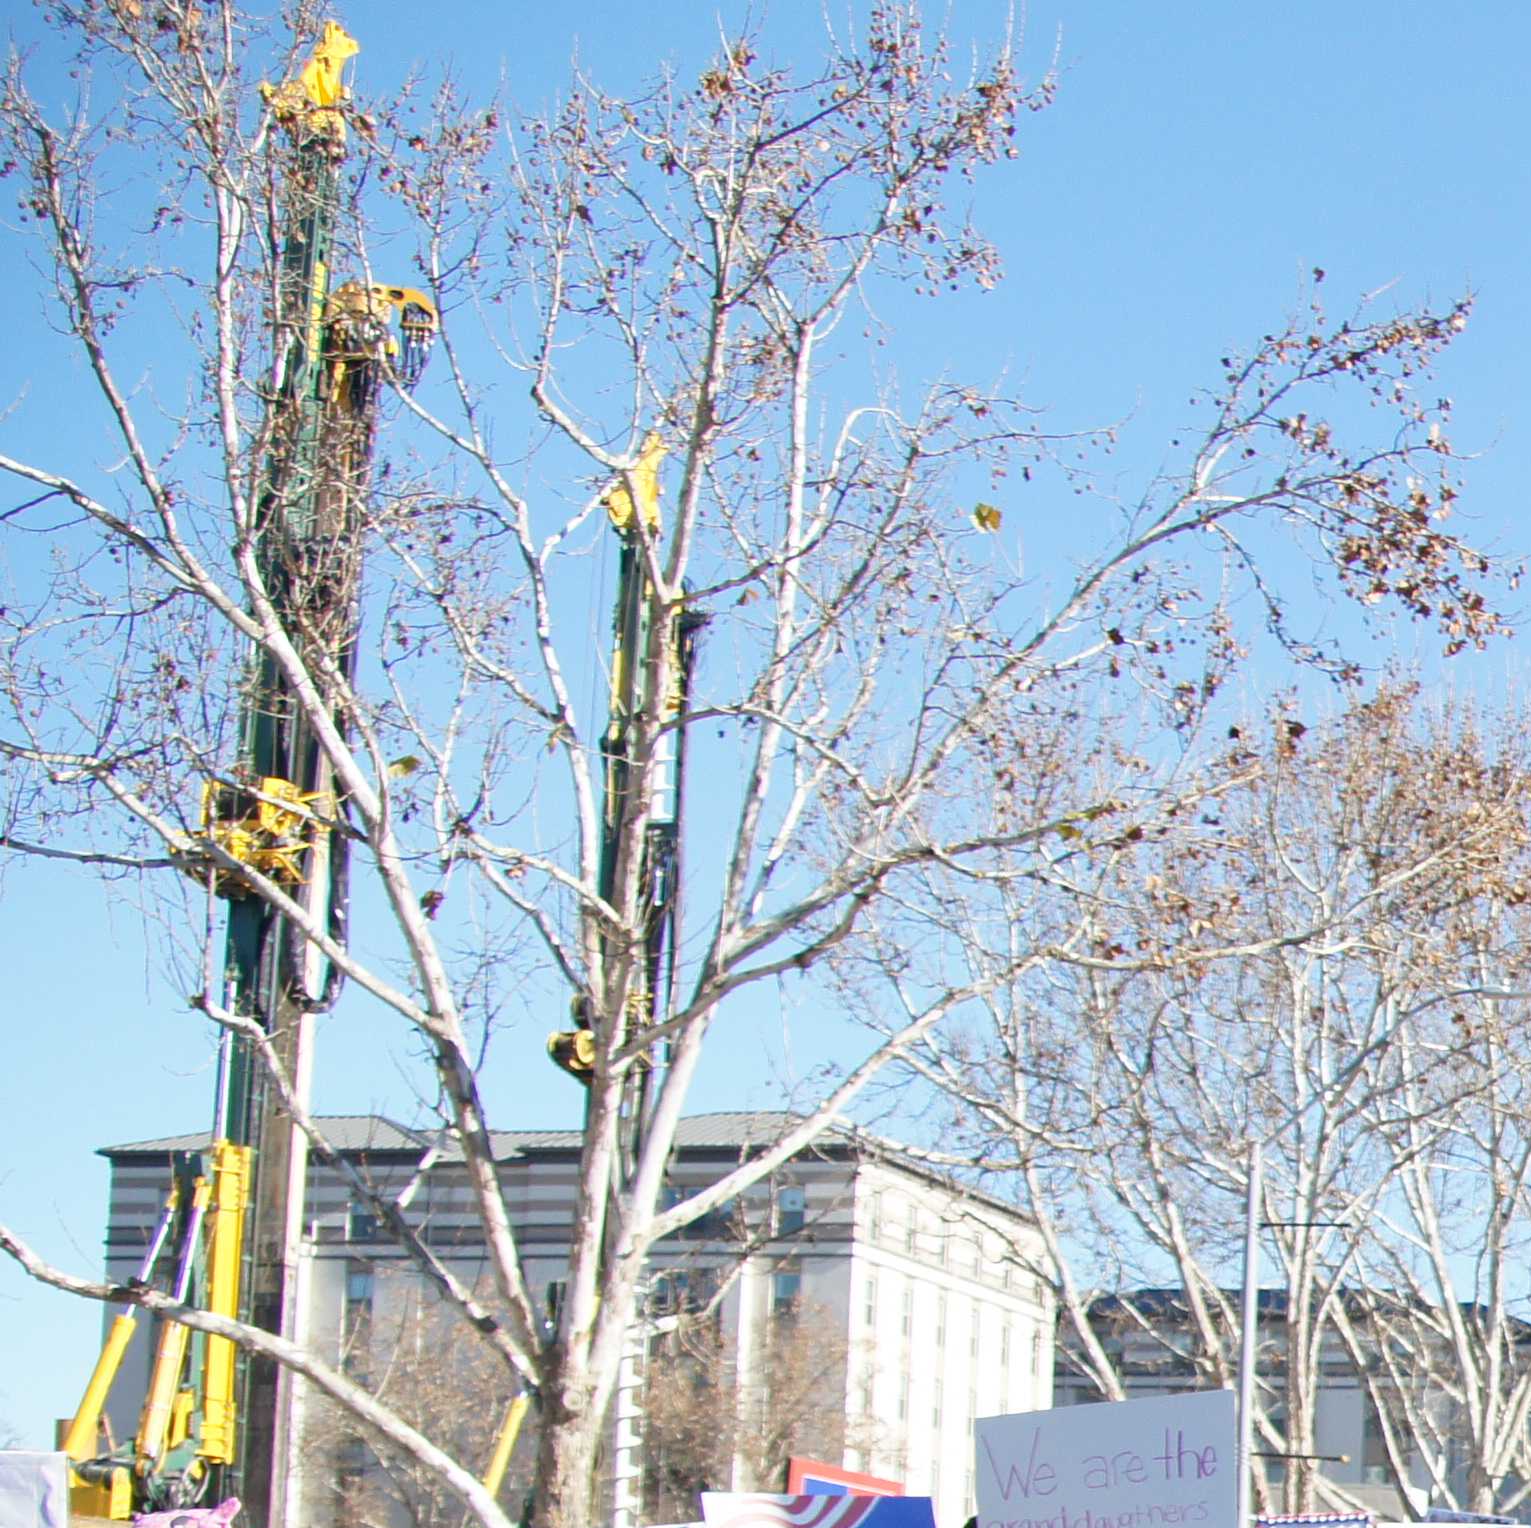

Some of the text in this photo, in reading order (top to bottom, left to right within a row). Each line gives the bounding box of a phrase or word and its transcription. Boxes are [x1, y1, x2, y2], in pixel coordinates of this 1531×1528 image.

[980, 1427, 1218, 1501] We are the
